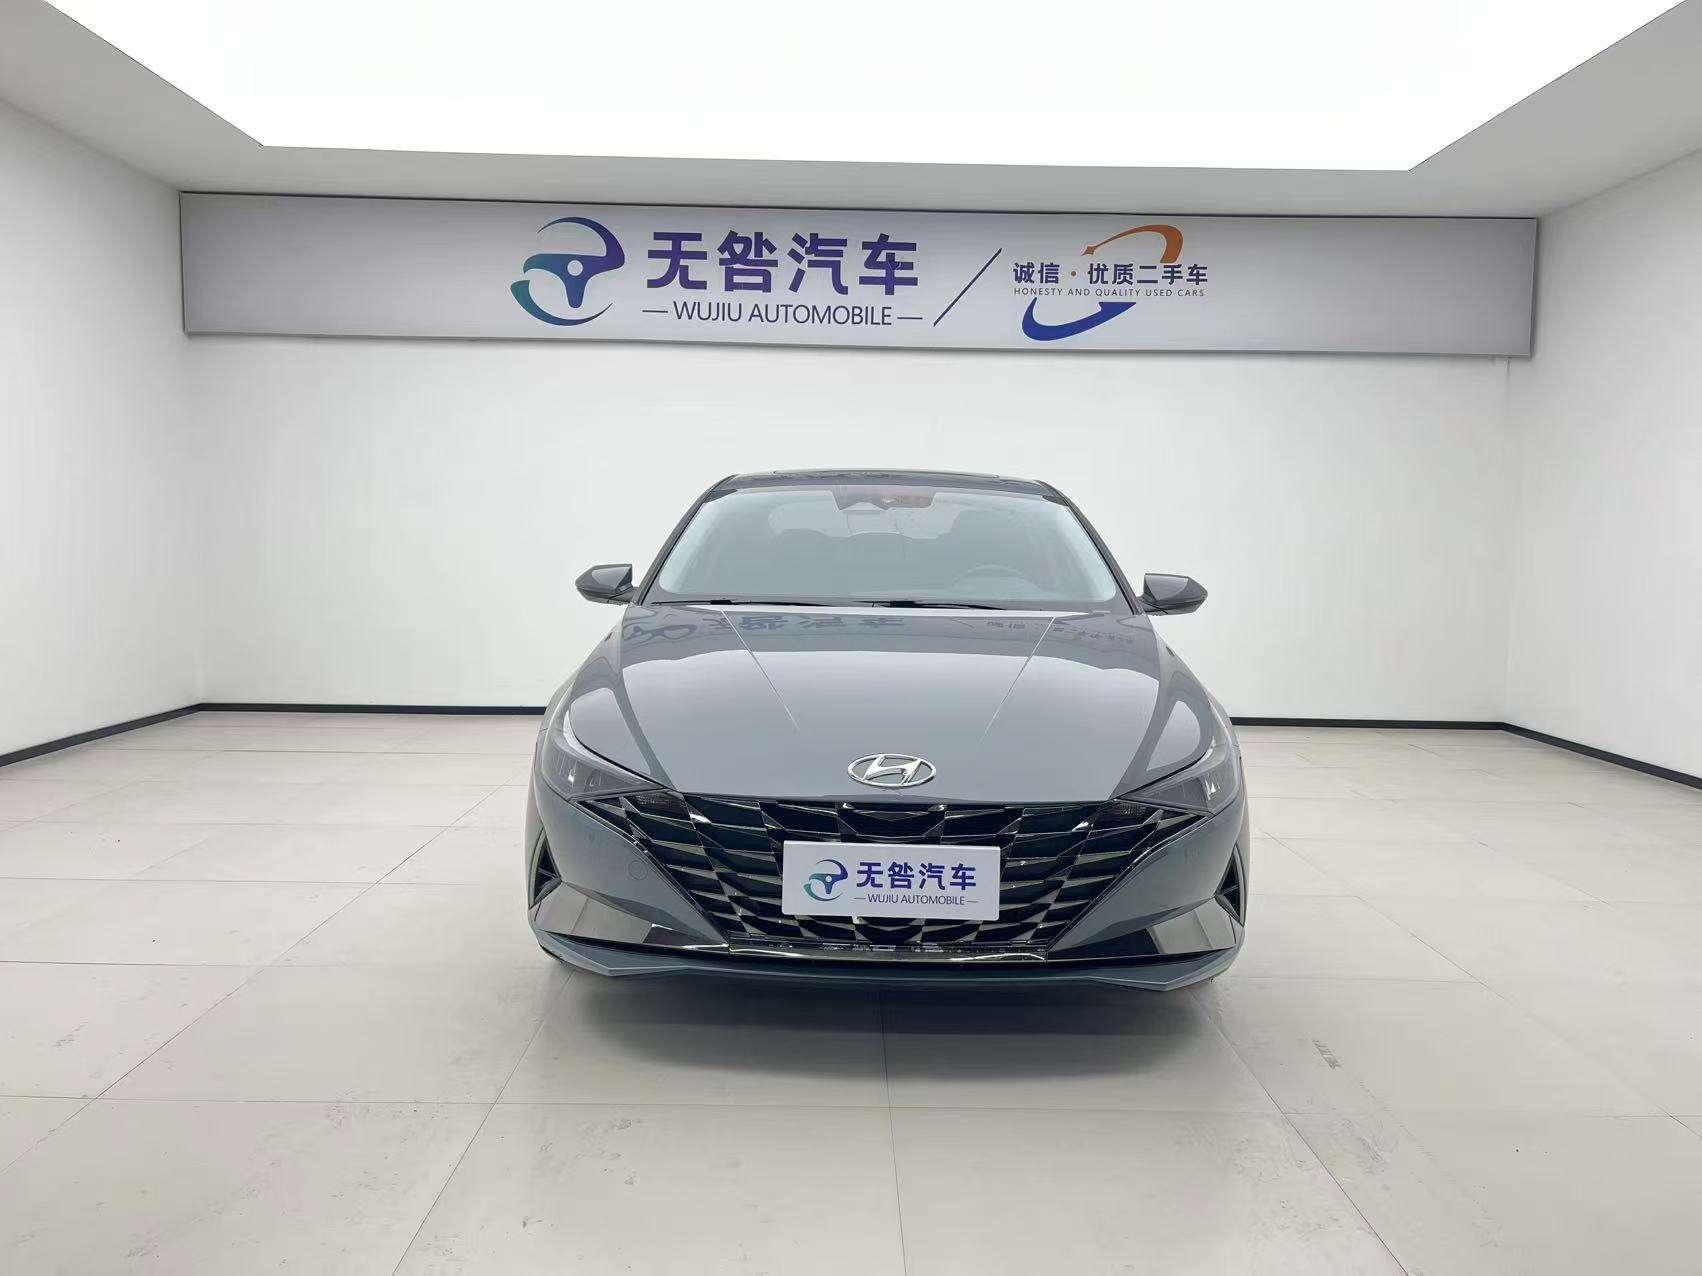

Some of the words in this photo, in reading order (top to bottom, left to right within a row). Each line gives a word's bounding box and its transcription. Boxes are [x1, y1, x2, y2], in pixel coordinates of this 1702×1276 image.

[1014, 287, 1063, 296] HONESTY
[1068, 288, 1090, 297] AND
[1095, 288, 1141, 297] QUALITY
[1145, 289, 1172, 297] USED
[1178, 289, 1205, 297] CARS
[673, 300, 743, 321] WUJIU
[748, 303, 892, 326] AUTOMOBILE
[867, 893, 899, 904] WUJIU
[900, 894, 965, 906] AUTOMOBILE
